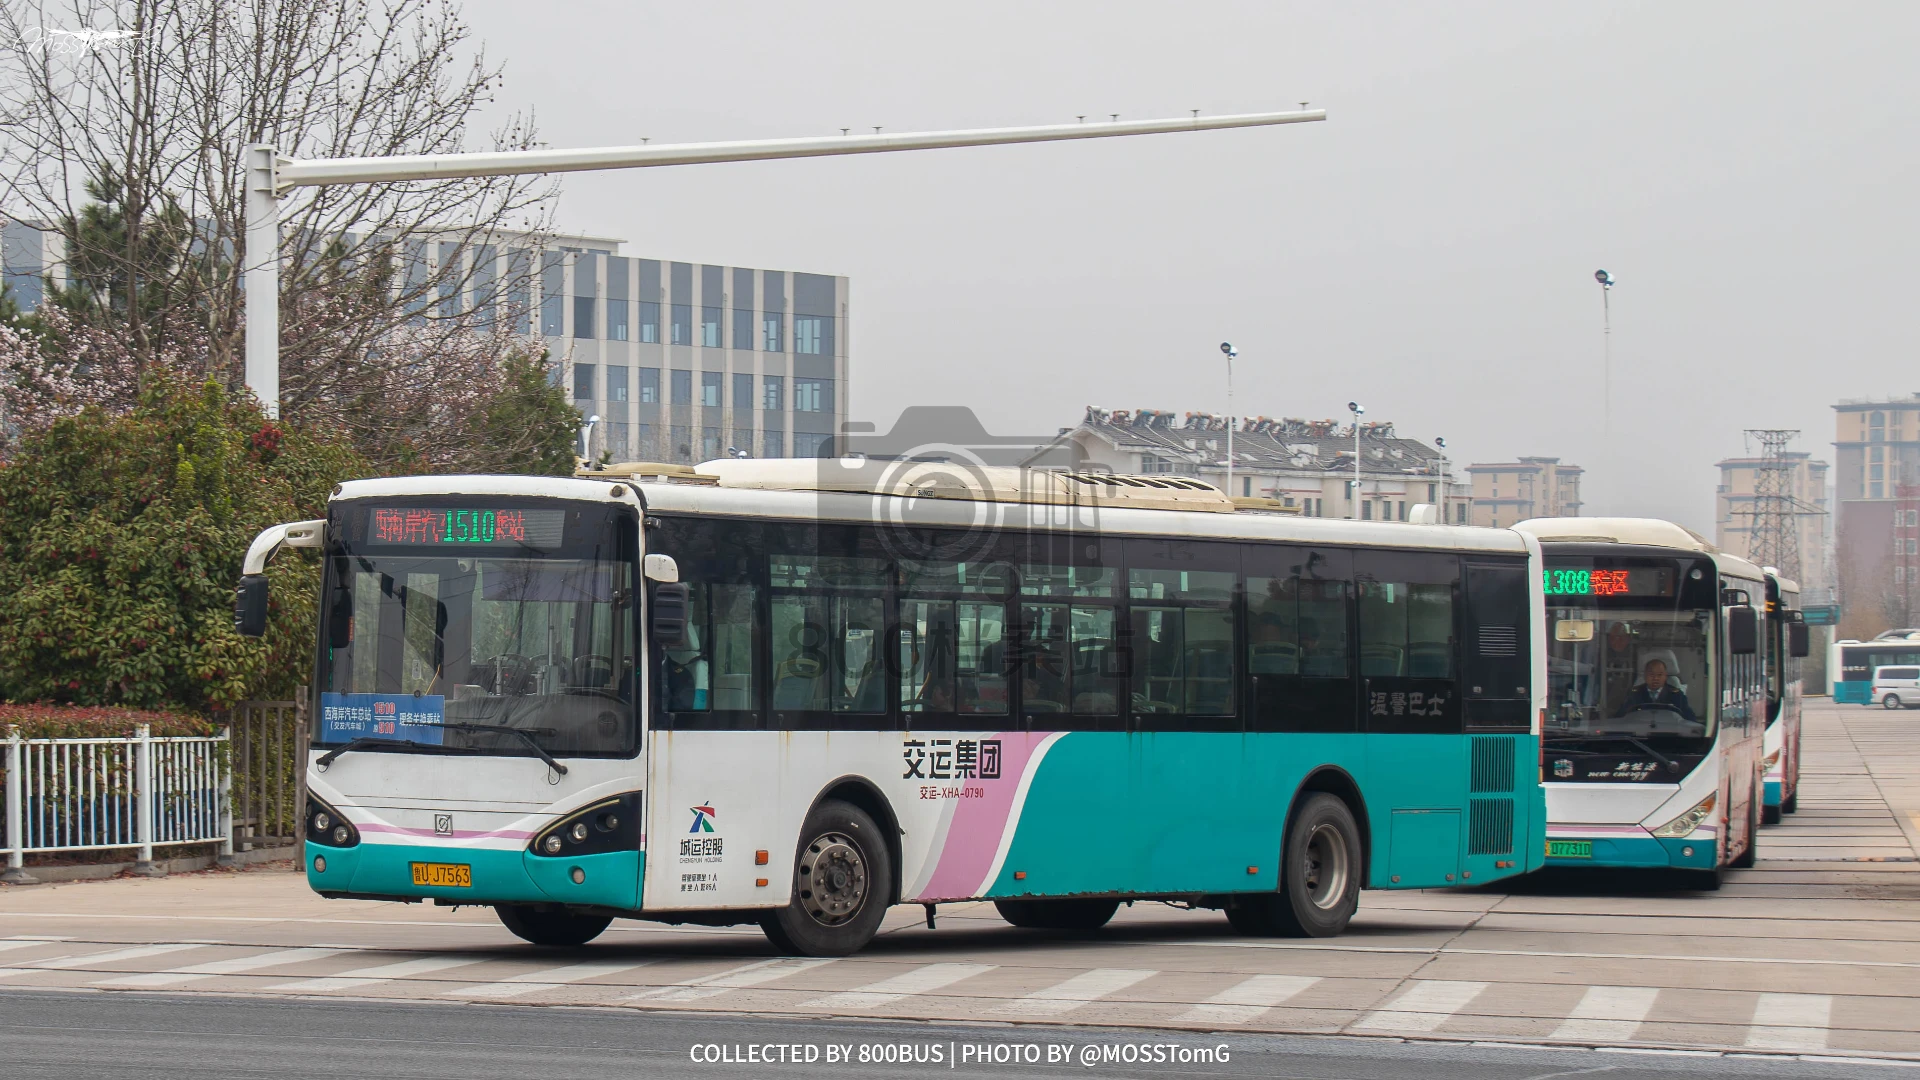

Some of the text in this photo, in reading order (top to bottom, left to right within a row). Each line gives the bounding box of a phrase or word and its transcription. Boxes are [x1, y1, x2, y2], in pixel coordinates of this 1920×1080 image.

[444, 510, 495, 542] 1510
[1543, 570, 1589, 594] 1308
[324, 705, 372, 722] 西海岸汽车总站
[903, 739, 1002, 779] 交运集团
[919, 786, 984, 800] 交运-XHA-0790
[680, 838, 723, 856] 城运控股
